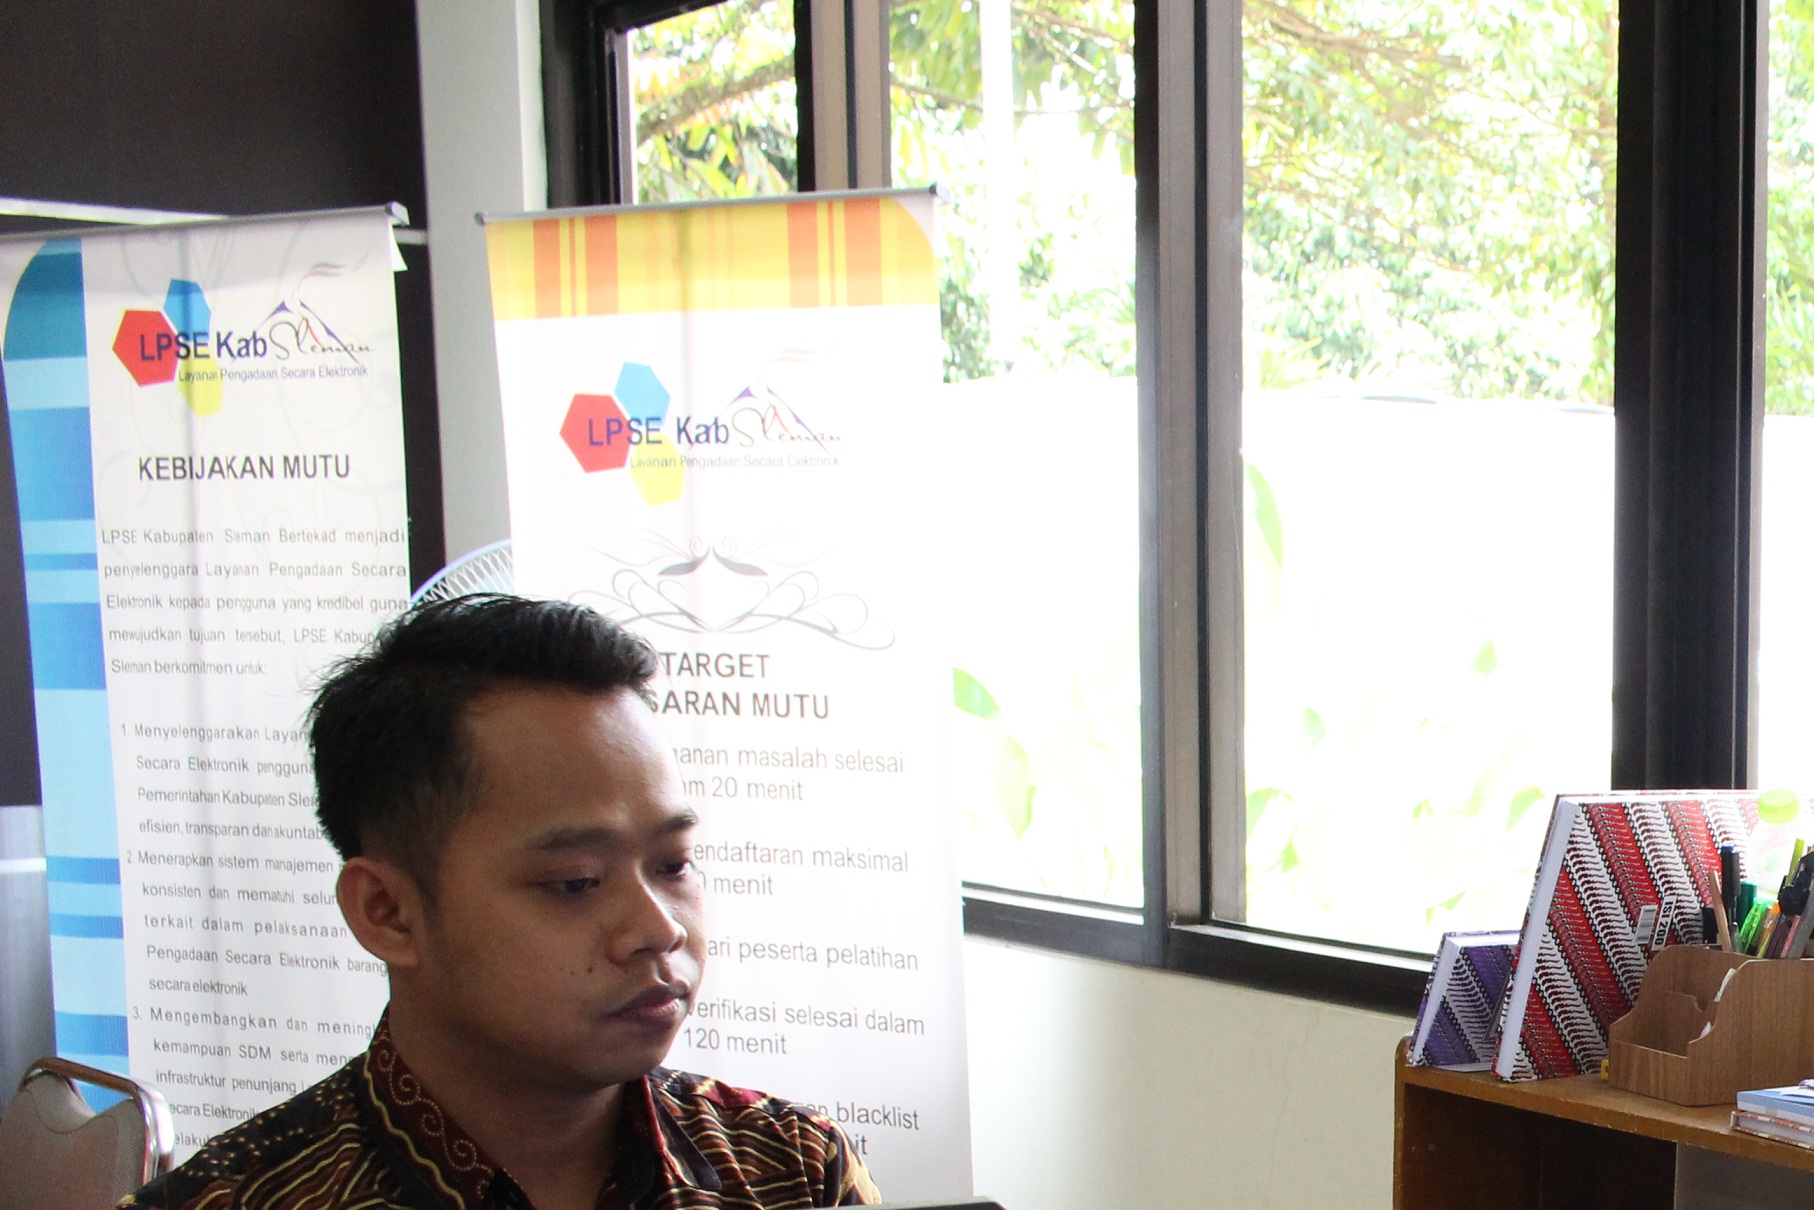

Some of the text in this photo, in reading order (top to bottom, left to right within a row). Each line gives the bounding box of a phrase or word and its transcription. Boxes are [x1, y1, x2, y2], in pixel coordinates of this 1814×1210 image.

[139, 331, 210, 361] LPSE
[216, 330, 267, 359] Kab
[220, 367, 278, 382] Pengadaan
[281, 367, 315, 380] Secara
[319, 365, 368, 378] Elektronik
[588, 417, 662, 445] LPSE
[676, 417, 729, 445] Kab
[139, 455, 349, 480] KEBIJAKAN MUTU
[744, 456, 783, 467] Secara
[102, 530, 136, 544] LPSE
[279, 528, 336, 543] Bertekad
[345, 529, 404, 546] menjadi
[104, 563, 198, 579] penyelenggara
[270, 561, 342, 580] Pengadaan
[352, 562, 406, 577] Secara
[107, 594, 163, 609] Elektronik
[169, 595, 210, 611] kepada
[217, 598, 276, 612] pengguna
[282, 598, 311, 613] yang
[317, 596, 363, 610] kredibel
[109, 627, 181, 644] mewujudkan
[189, 628, 225, 645] tujuan
[294, 628, 327, 643] LPSE
[154, 660, 232, 674] berkomitmen
[659, 651, 770, 679] TARGET
[753, 693, 828, 719] MUTU
[135, 724, 259, 743] Menyelenggarakan
[137, 755, 180, 770] Secara
[188, 757, 249, 772] Elektronik
[738, 747, 827, 768] masalah
[835, 750, 903, 773] selesai
[712, 776, 738, 798] 20
[747, 779, 804, 801] menit
[186, 822, 249, 837] transparan
[138, 851, 213, 868] Menerapkan
[218, 856, 259, 869] sistem
[265, 858, 333, 875] manajemen
[694, 840, 908, 872] endaftaran maksimal
[143, 882, 201, 898] konsisten
[209, 885, 229, 899] dan
[714, 873, 774, 896] menit
[145, 915, 193, 929] terkait
[202, 917, 243, 932] dalam
[1654, 902, 1673, 945] ISI 200
[147, 945, 218, 963] Pengadaan
[226, 949, 271, 965] Secara
[280, 952, 339, 969] Elektronik
[739, 943, 817, 963] peserta
[827, 944, 918, 970] pelatihan
[149, 979, 247, 996] secara elektronik
[151, 1007, 276, 1030] Mengembangkan
[287, 1017, 307, 1031] dan
[785, 1005, 857, 1028] selesai
[866, 1010, 924, 1035] dalam
[154, 1039, 231, 1058] kemampuan
[239, 1045, 271, 1059] SDM
[684, 1027, 787, 1054] 120 menit
[156, 1070, 226, 1088] infrastruktur
[232, 1075, 297, 1094] penunjang
[170, 1105, 200, 1116] ecara
[837, 1102, 920, 1130] blacklist
